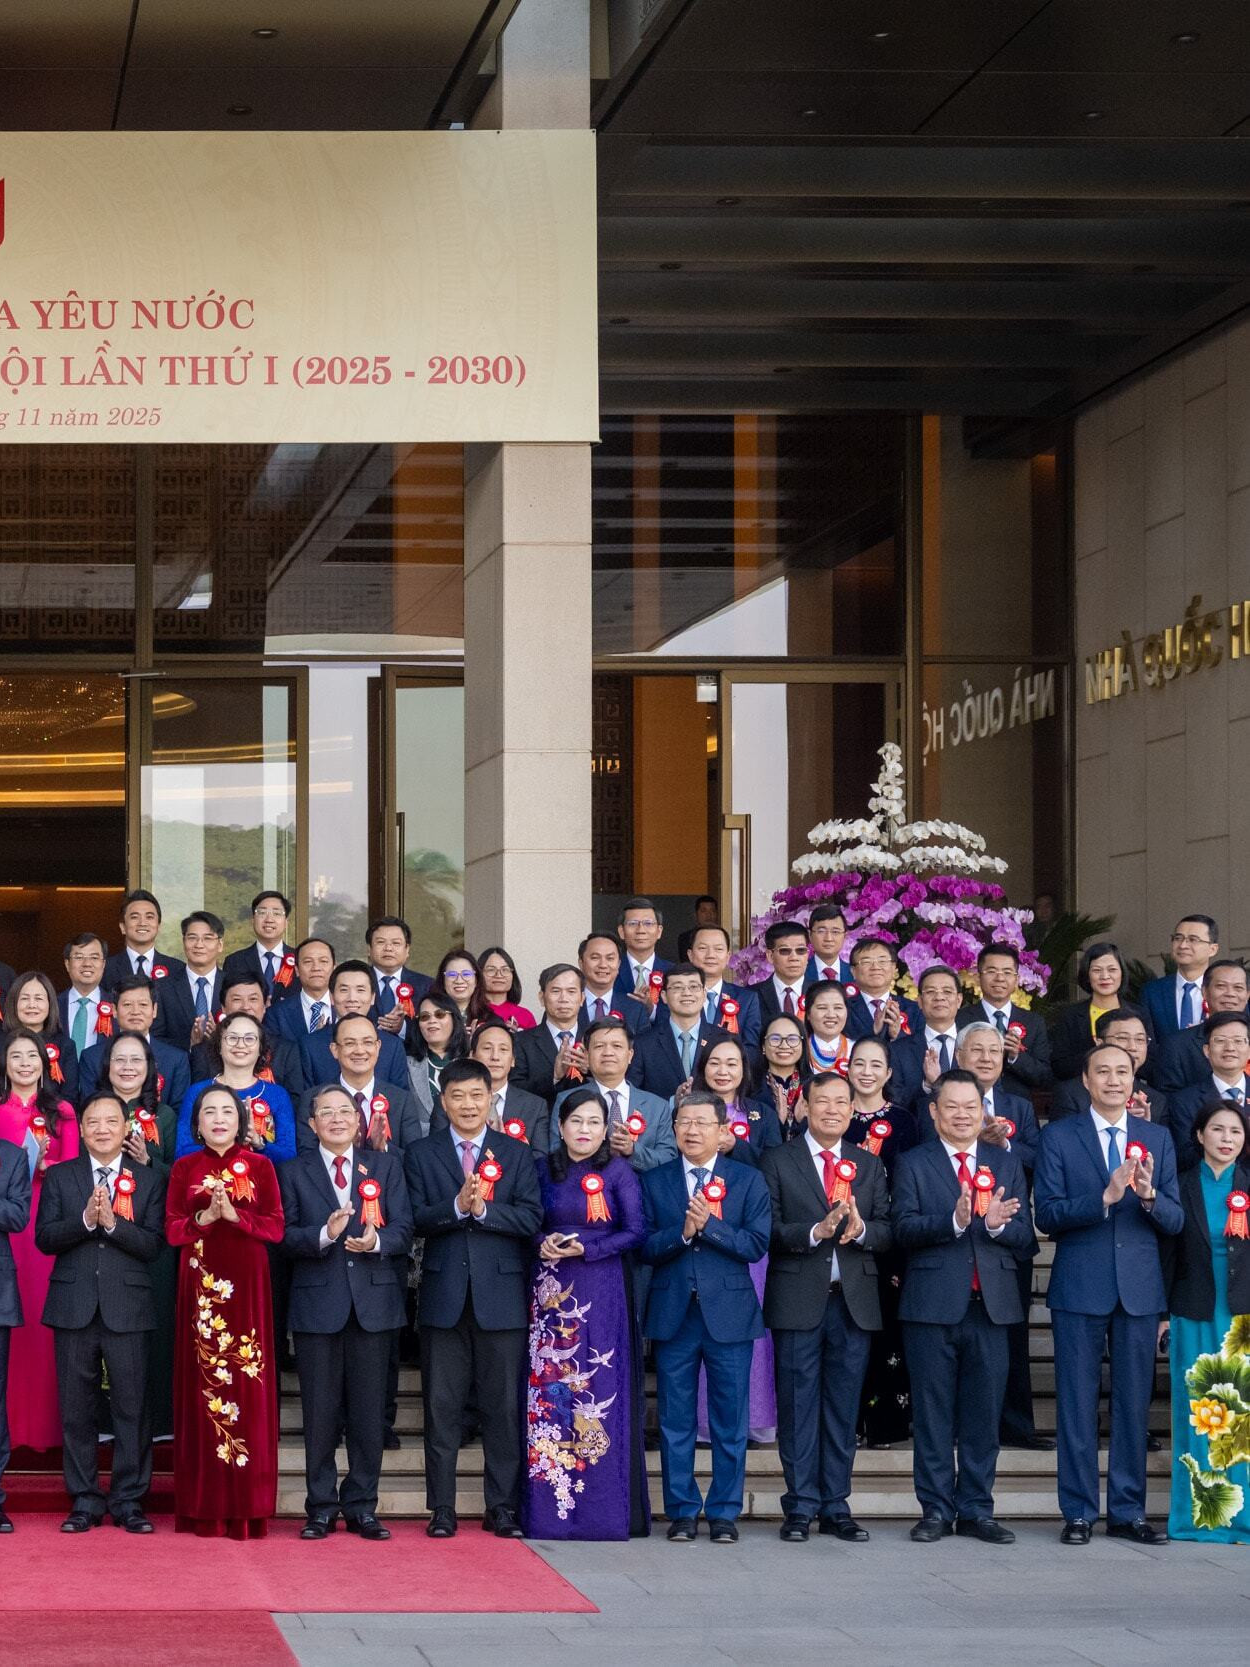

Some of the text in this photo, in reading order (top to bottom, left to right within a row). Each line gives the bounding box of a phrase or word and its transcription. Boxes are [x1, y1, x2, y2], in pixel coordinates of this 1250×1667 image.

[30, 289, 119, 330] YÊU
[131, 288, 255, 330] NƯỚC
[60, 340, 147, 386] LẦN
[159, 346, 254, 386] THỨ
[263, 356, 279, 385] I
[292, 355, 393, 389] (2025
[427, 354, 527, 388] 2030)
[16, 407, 42, 426] 11
[49, 407, 99, 427] năm
[106, 407, 162, 427] 2025
[1085, 630, 1139, 704] NHÀ
